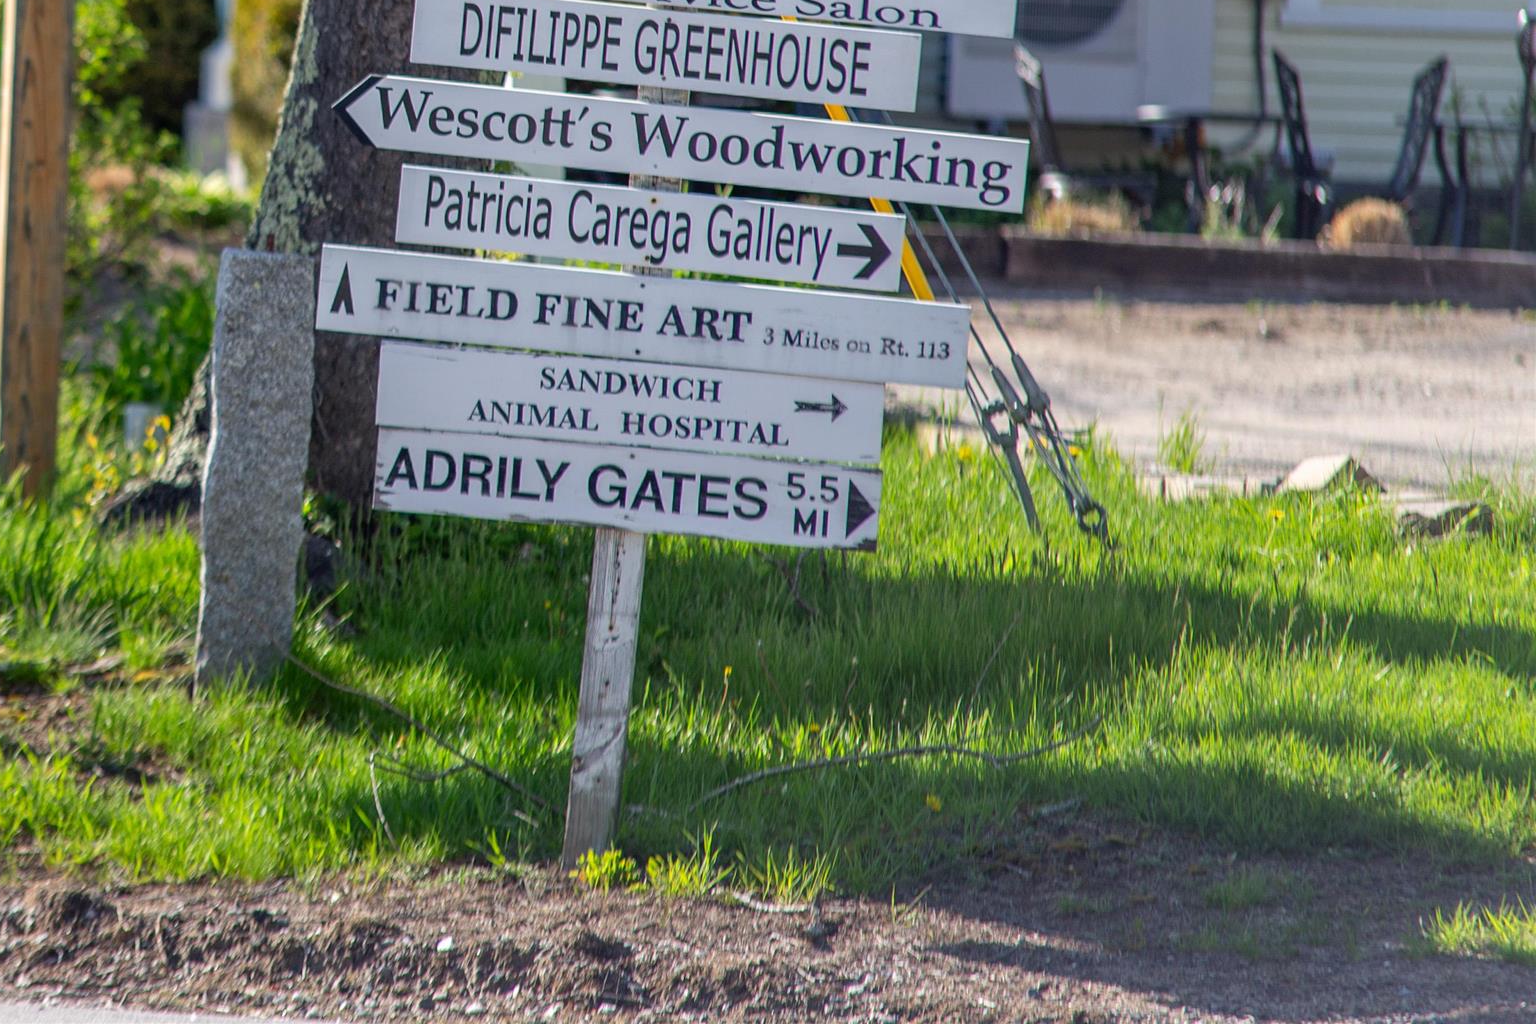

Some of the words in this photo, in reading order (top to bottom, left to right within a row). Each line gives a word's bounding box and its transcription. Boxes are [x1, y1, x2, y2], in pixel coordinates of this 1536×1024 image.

[459, 2, 621, 72] DIFILIPPE
[632, 22, 872, 98] GREENHOUSE
[374, 86, 614, 154] Wescott's
[630, 111, 1014, 207] Woodworking
[423, 175, 553, 241] Patricia
[567, 189, 692, 263] Carega
[706, 203, 832, 280] Gallery
[374, 279, 520, 323] FIELD
[533, 292, 645, 334] FINE
[657, 305, 754, 343] ART
[762, 328, 776, 348] 3
[780, 329, 841, 352] Miles
[845, 339, 872, 353] on
[879, 337, 911, 358] Rt.
[916, 340, 951, 360] 113
[538, 366, 722, 404] SANDWICH
[467, 398, 600, 432] ANIMAL
[620, 412, 790, 448] HOSPITAL
[383, 446, 571, 504] ADRILY
[587, 463, 768, 521] GATES
[786, 473, 840, 504] 5.5
[794, 508, 830, 538] MI
